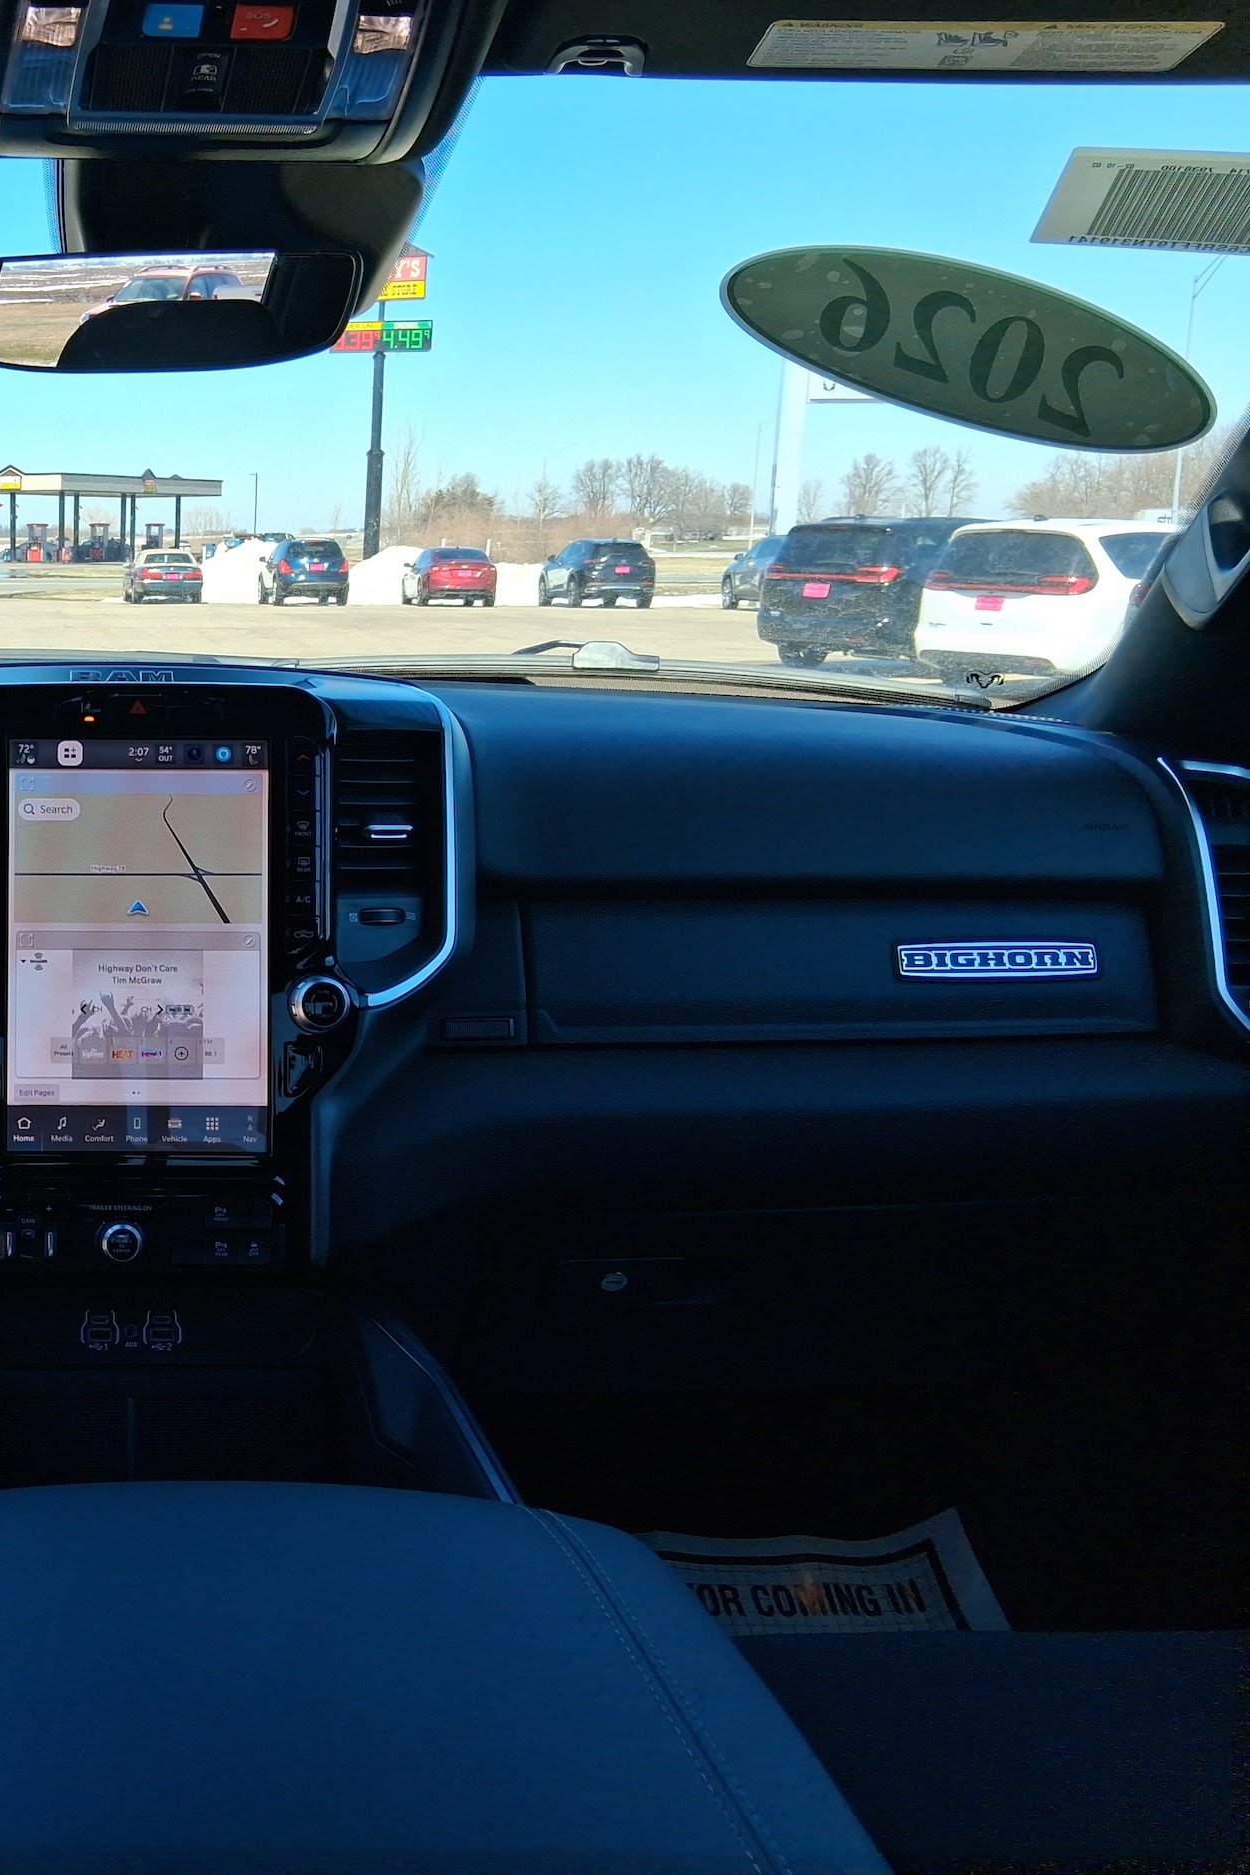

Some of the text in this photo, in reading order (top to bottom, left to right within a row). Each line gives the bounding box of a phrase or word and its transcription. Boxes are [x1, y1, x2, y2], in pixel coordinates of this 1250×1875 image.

[70, 670, 175, 682] RAM
[128, 747, 149, 757] 2:07
[40, 804, 73, 814] Search
[901, 949, 1095, 971] BIGHORN
[98, 964, 179, 974] Highway Don't Care
[112, 977, 163, 985] Tim McGraw
[112, 1050, 133, 1059] HEAT
[19, 1089, 55, 1098] Edit Pages
[13, 1134, 35, 1142] Home
[50, 1134, 73, 1142] Media
[85, 1134, 115, 1143] Comfort
[125, 1134, 149, 1143] Phone
[161, 1135, 188, 1143] Vehicle
[203, 1135, 222, 1144] Apps
[242, 1135, 258, 1143] Nav
[685, 1578, 927, 1617] OR COMING IN
